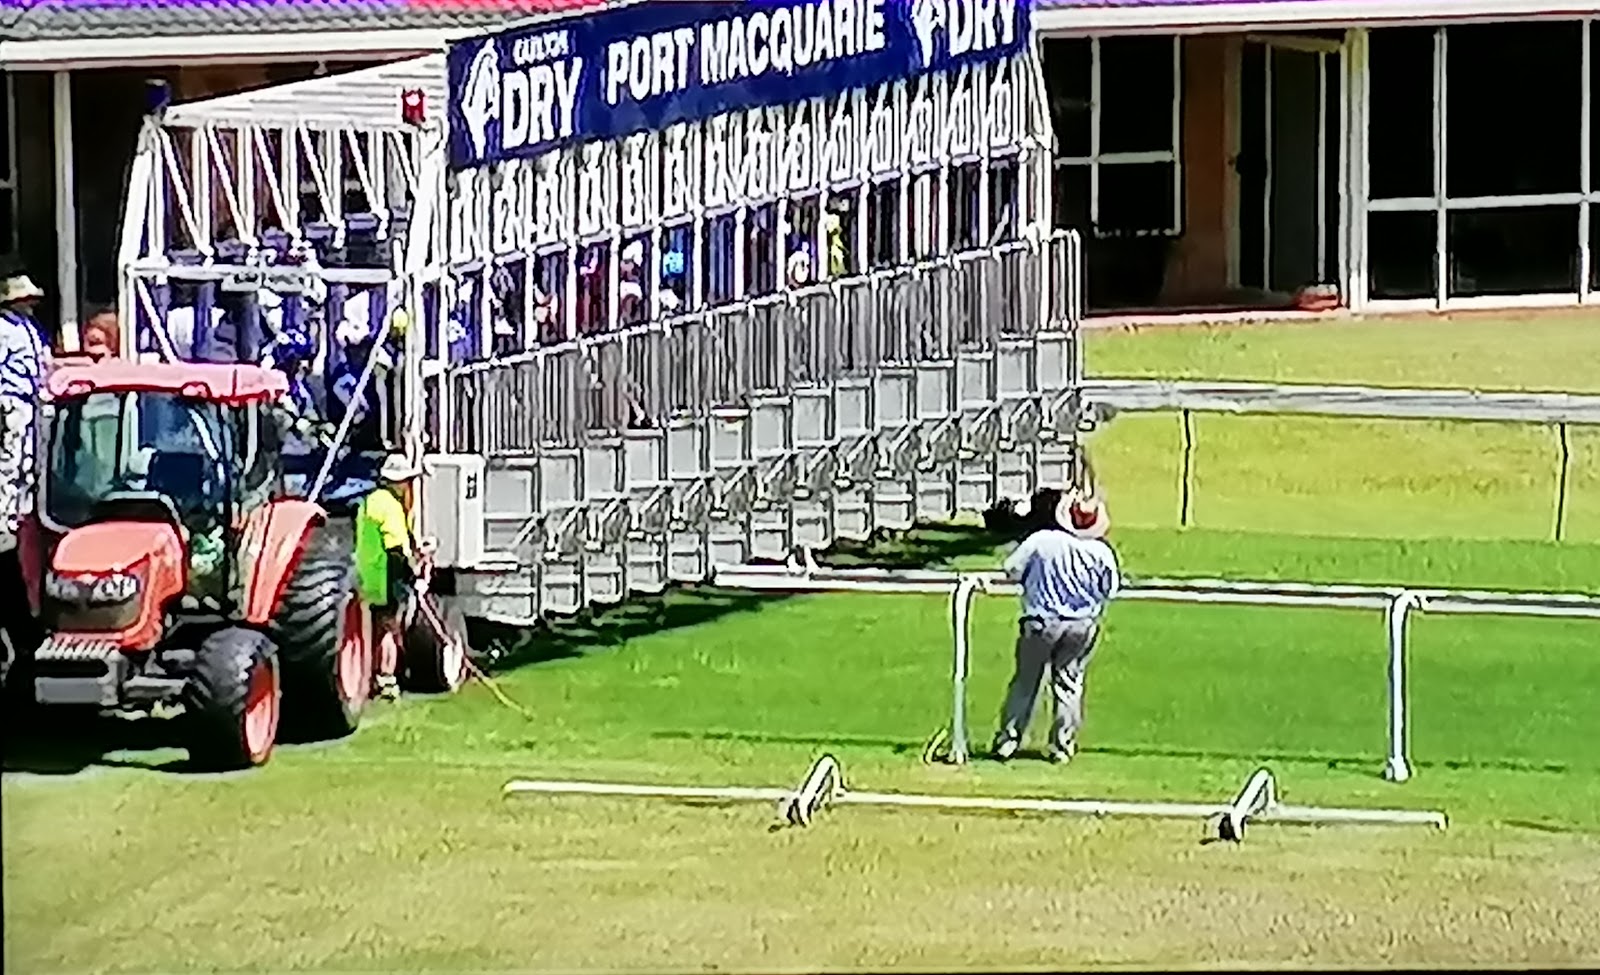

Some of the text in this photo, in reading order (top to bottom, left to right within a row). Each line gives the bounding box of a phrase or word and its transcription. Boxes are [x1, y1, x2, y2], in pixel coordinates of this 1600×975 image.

[607, 27, 695, 105] PORT
[700, 0, 886, 85] MACQUARIE
[948, 0, 1015, 57] DRY
[502, 56, 583, 150] DRY
